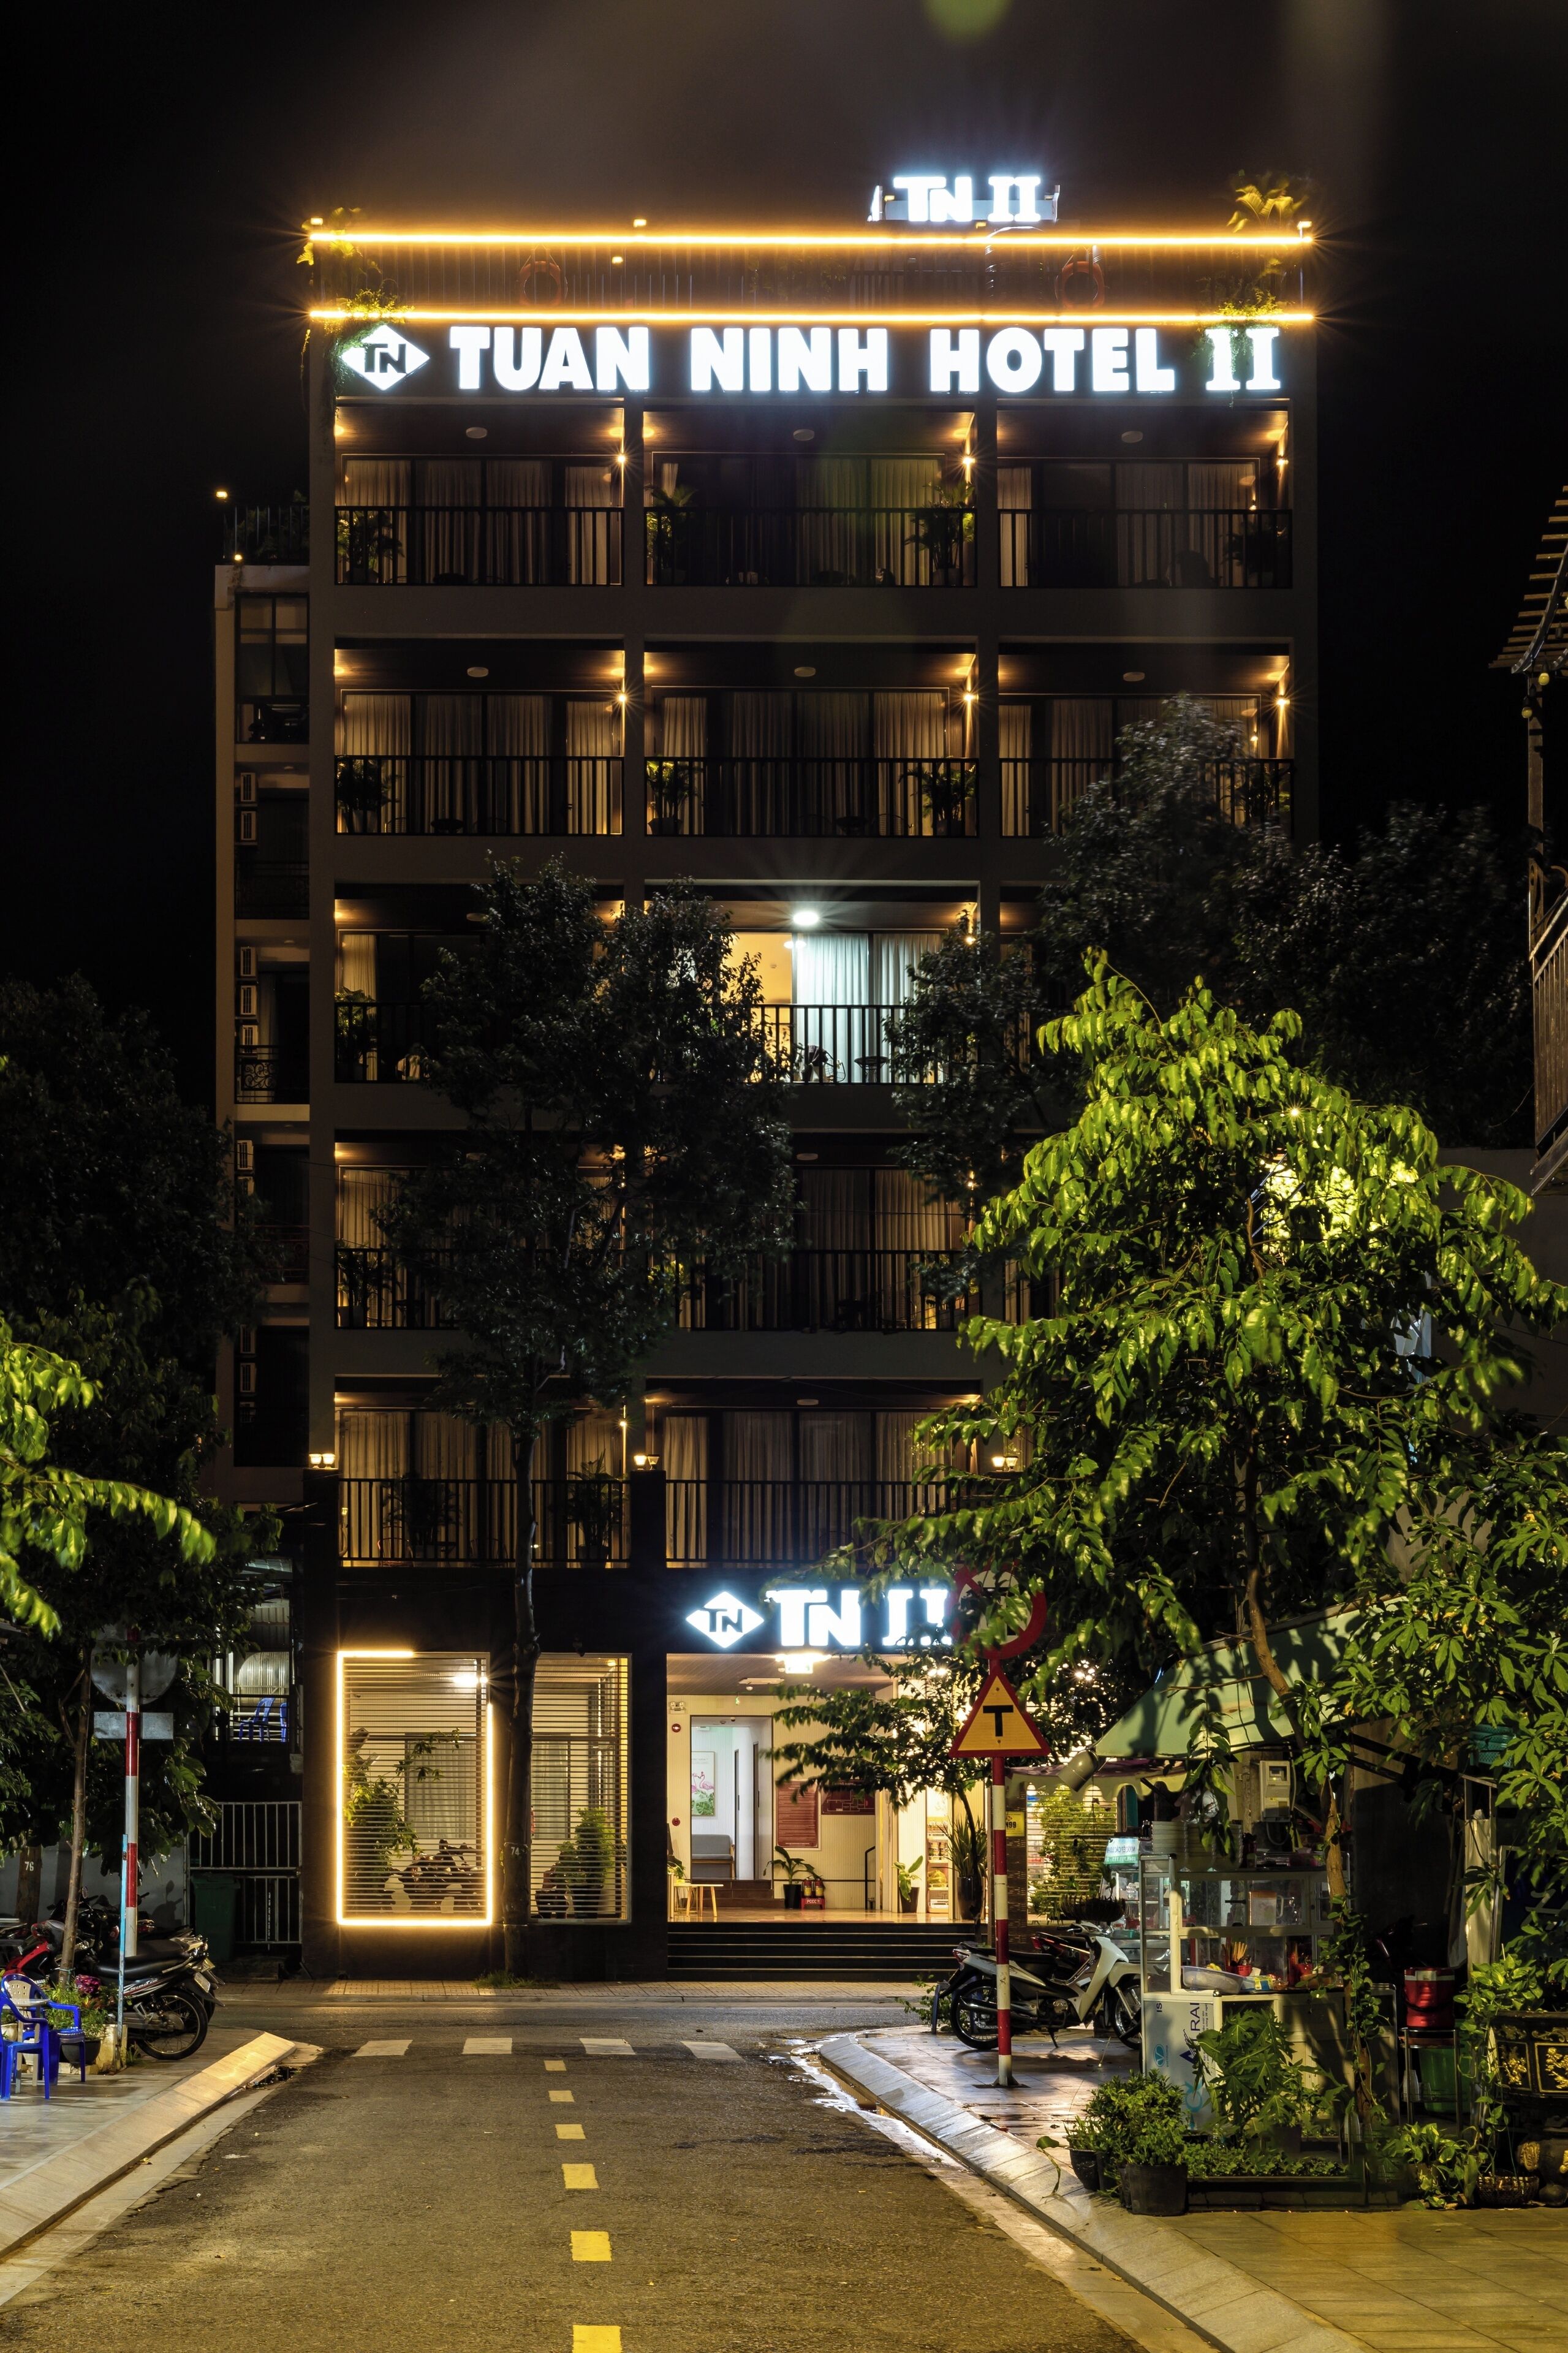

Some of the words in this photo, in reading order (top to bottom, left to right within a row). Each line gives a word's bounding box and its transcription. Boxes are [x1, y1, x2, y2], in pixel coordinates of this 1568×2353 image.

[893, 175, 974, 222] TN
[987, 175, 1041, 222] II
[450, 326, 650, 391] TUAN
[691, 327, 888, 392] NINH
[930, 327, 1175, 393] HOTEL
[1205, 327, 1281, 391] II
[702, 1608, 743, 1633] TN
[764, 1590, 861, 1646] TN
[25, 1861, 34, 1871] 76
[511, 1846, 520, 1855] 74
